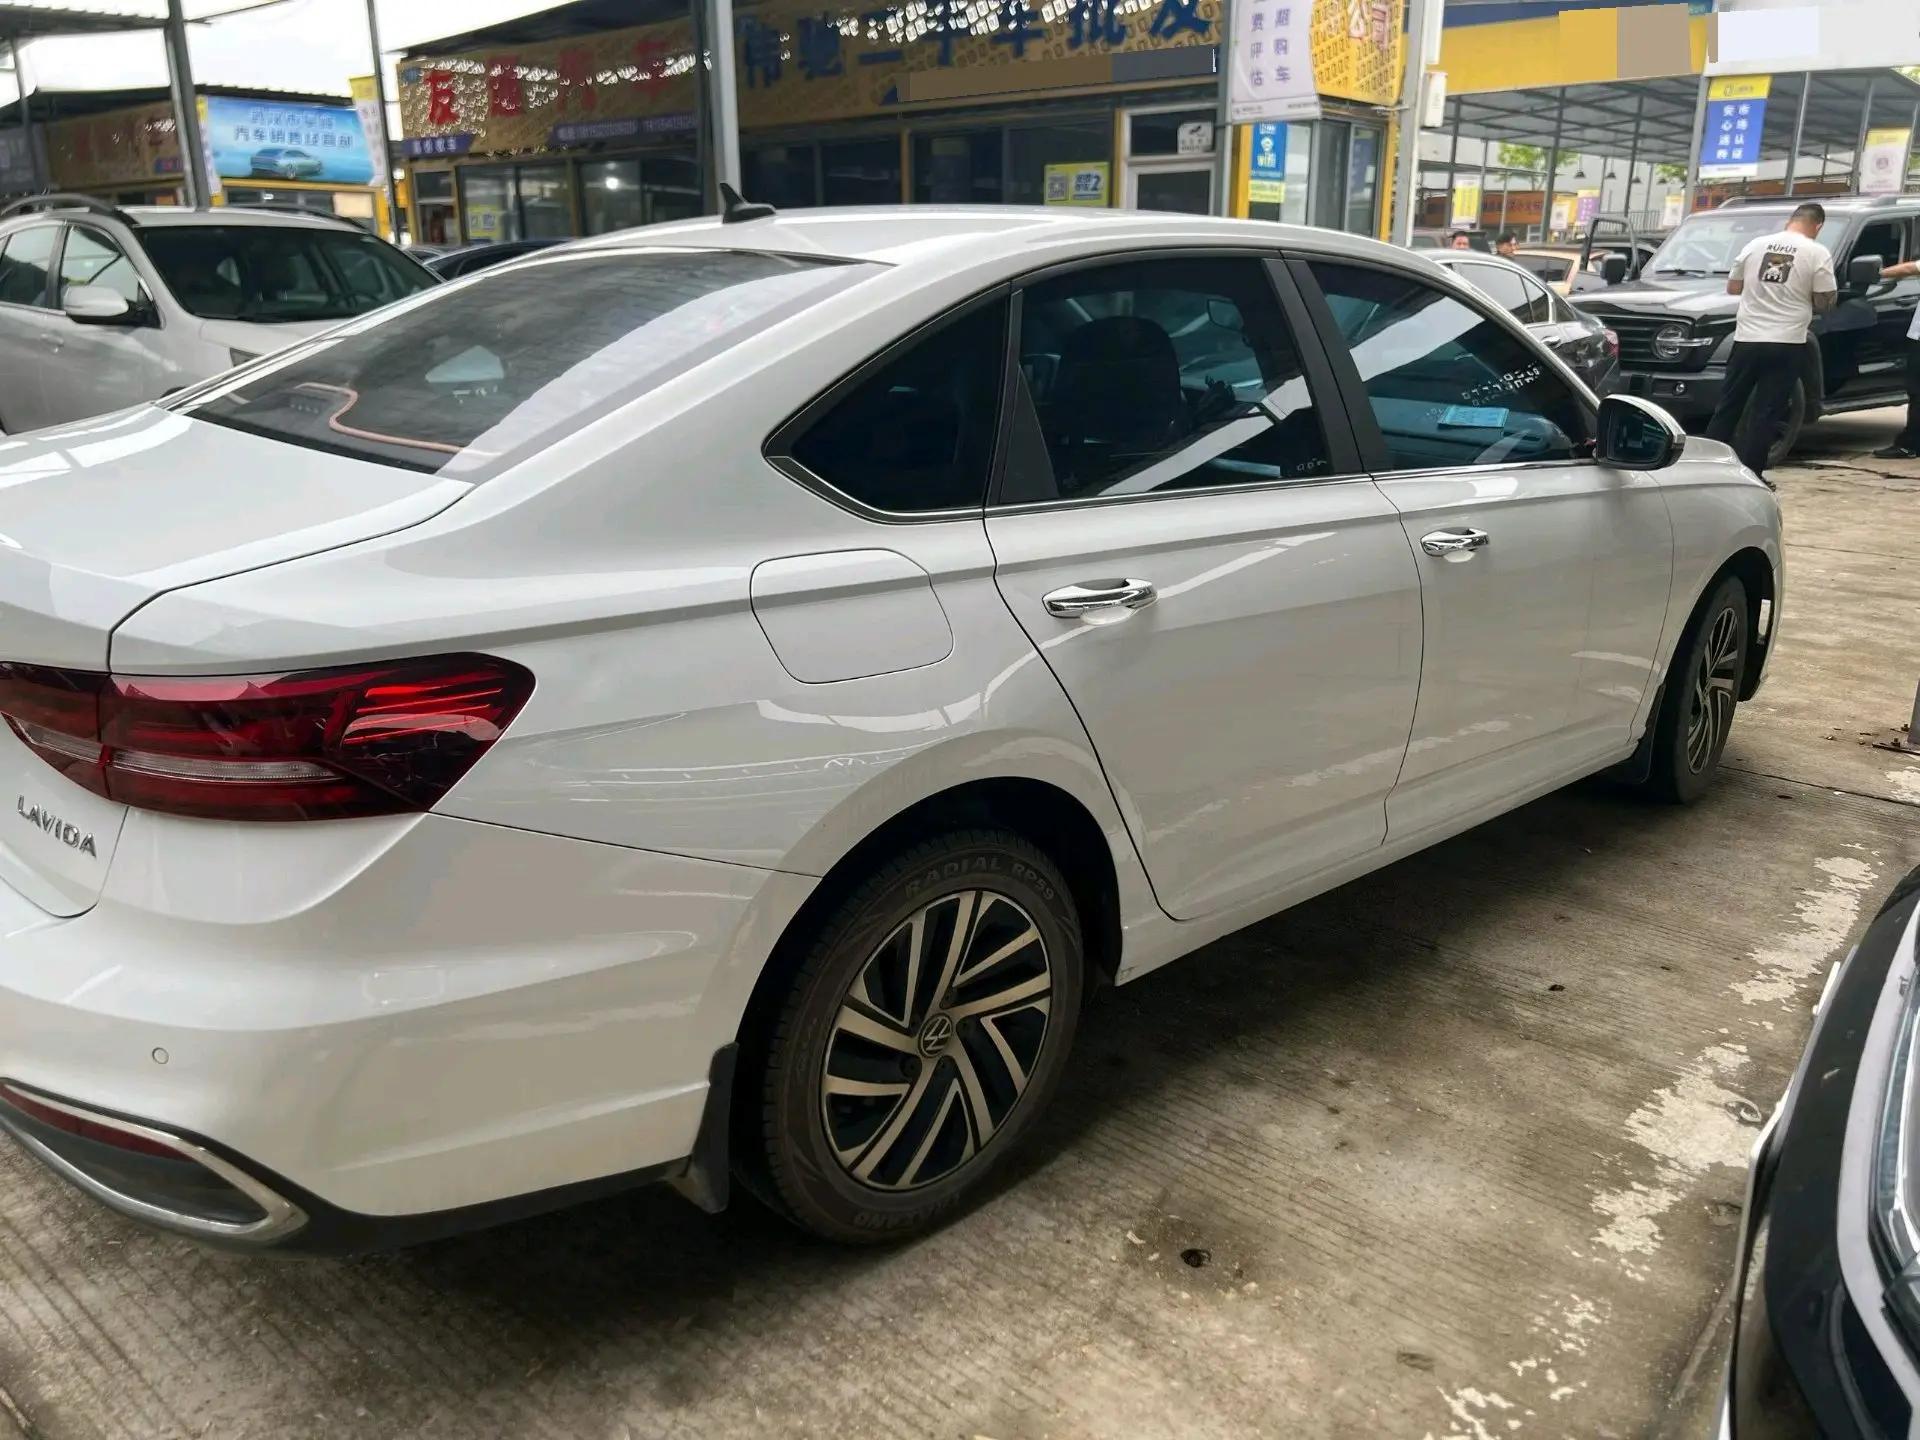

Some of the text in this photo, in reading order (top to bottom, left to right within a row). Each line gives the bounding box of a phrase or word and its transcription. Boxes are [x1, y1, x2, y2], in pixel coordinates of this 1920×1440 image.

[1250, 0, 1264, 87] 费评估
[17, 795, 97, 858] LAVIDA
[905, 856, 1001, 898] RADIAL
